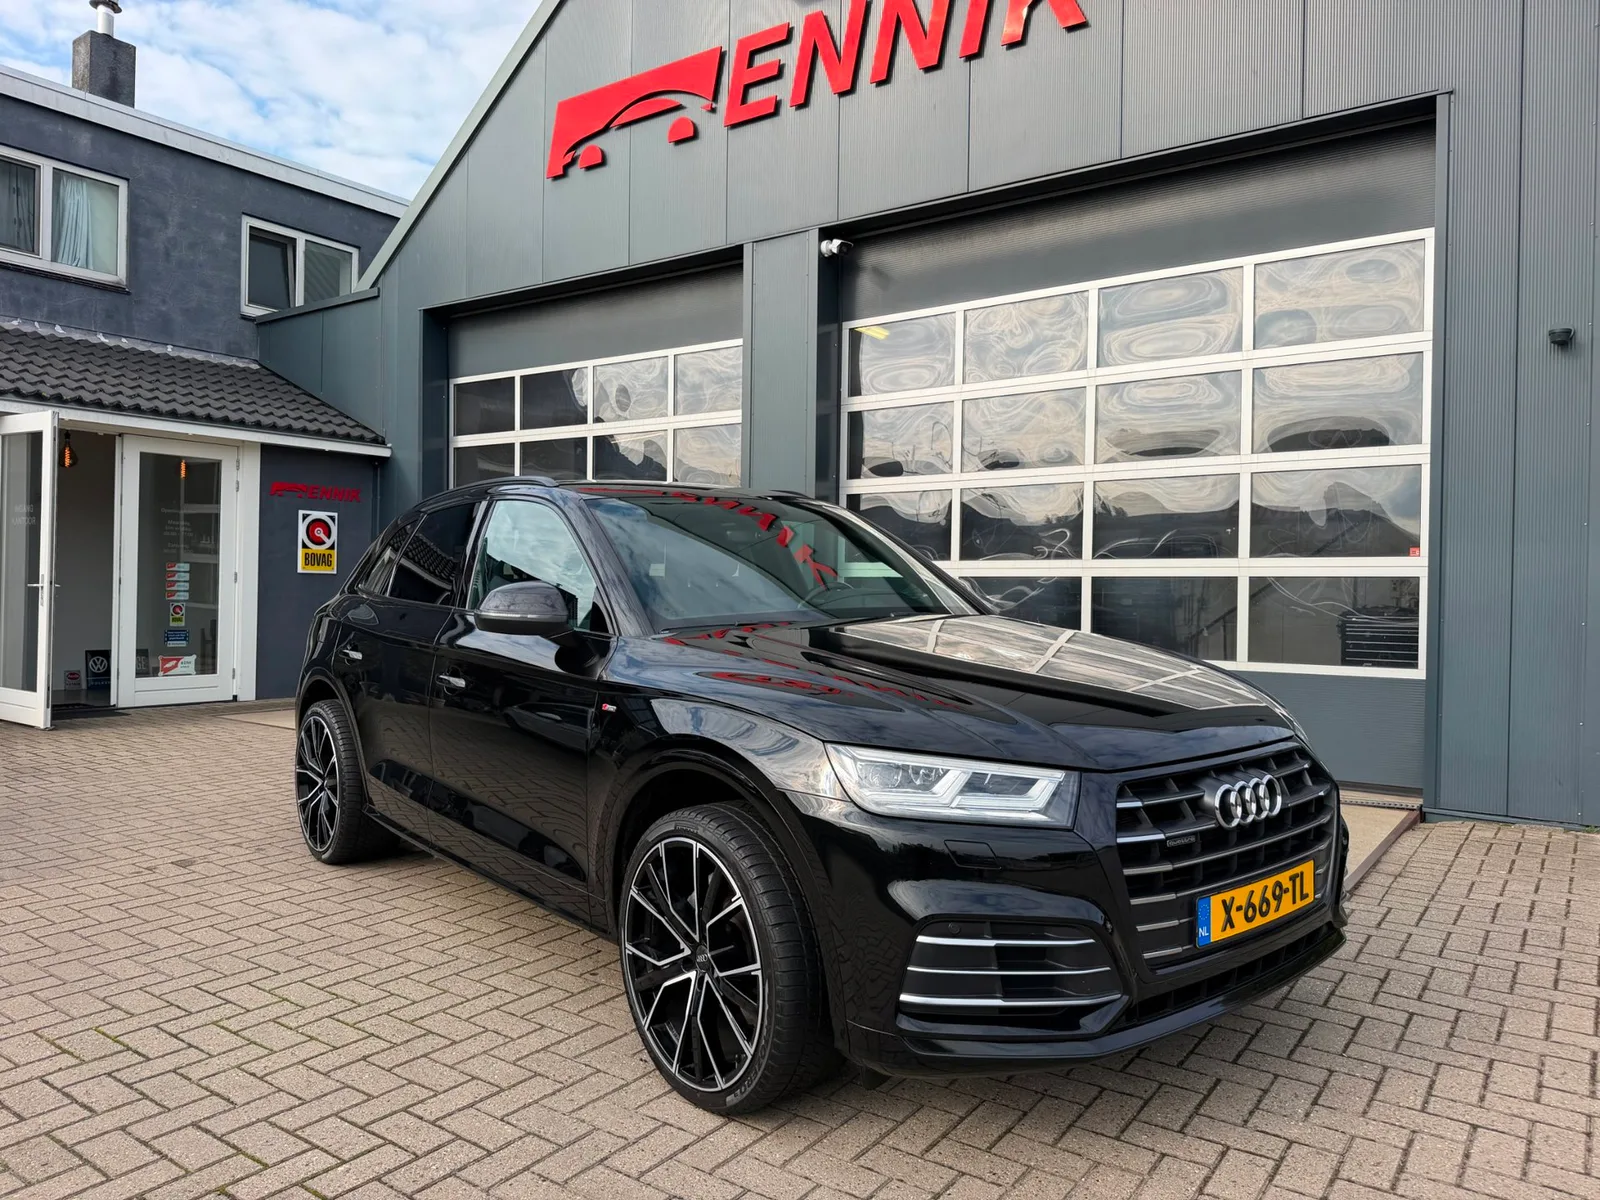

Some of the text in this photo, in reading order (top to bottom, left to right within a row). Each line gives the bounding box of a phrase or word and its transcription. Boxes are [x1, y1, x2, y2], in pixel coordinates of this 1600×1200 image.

[304, 552, 332, 567] BOVAG
[1221, 871, 1309, 932] X-669-TL
[1199, 927, 1209, 937] NL
